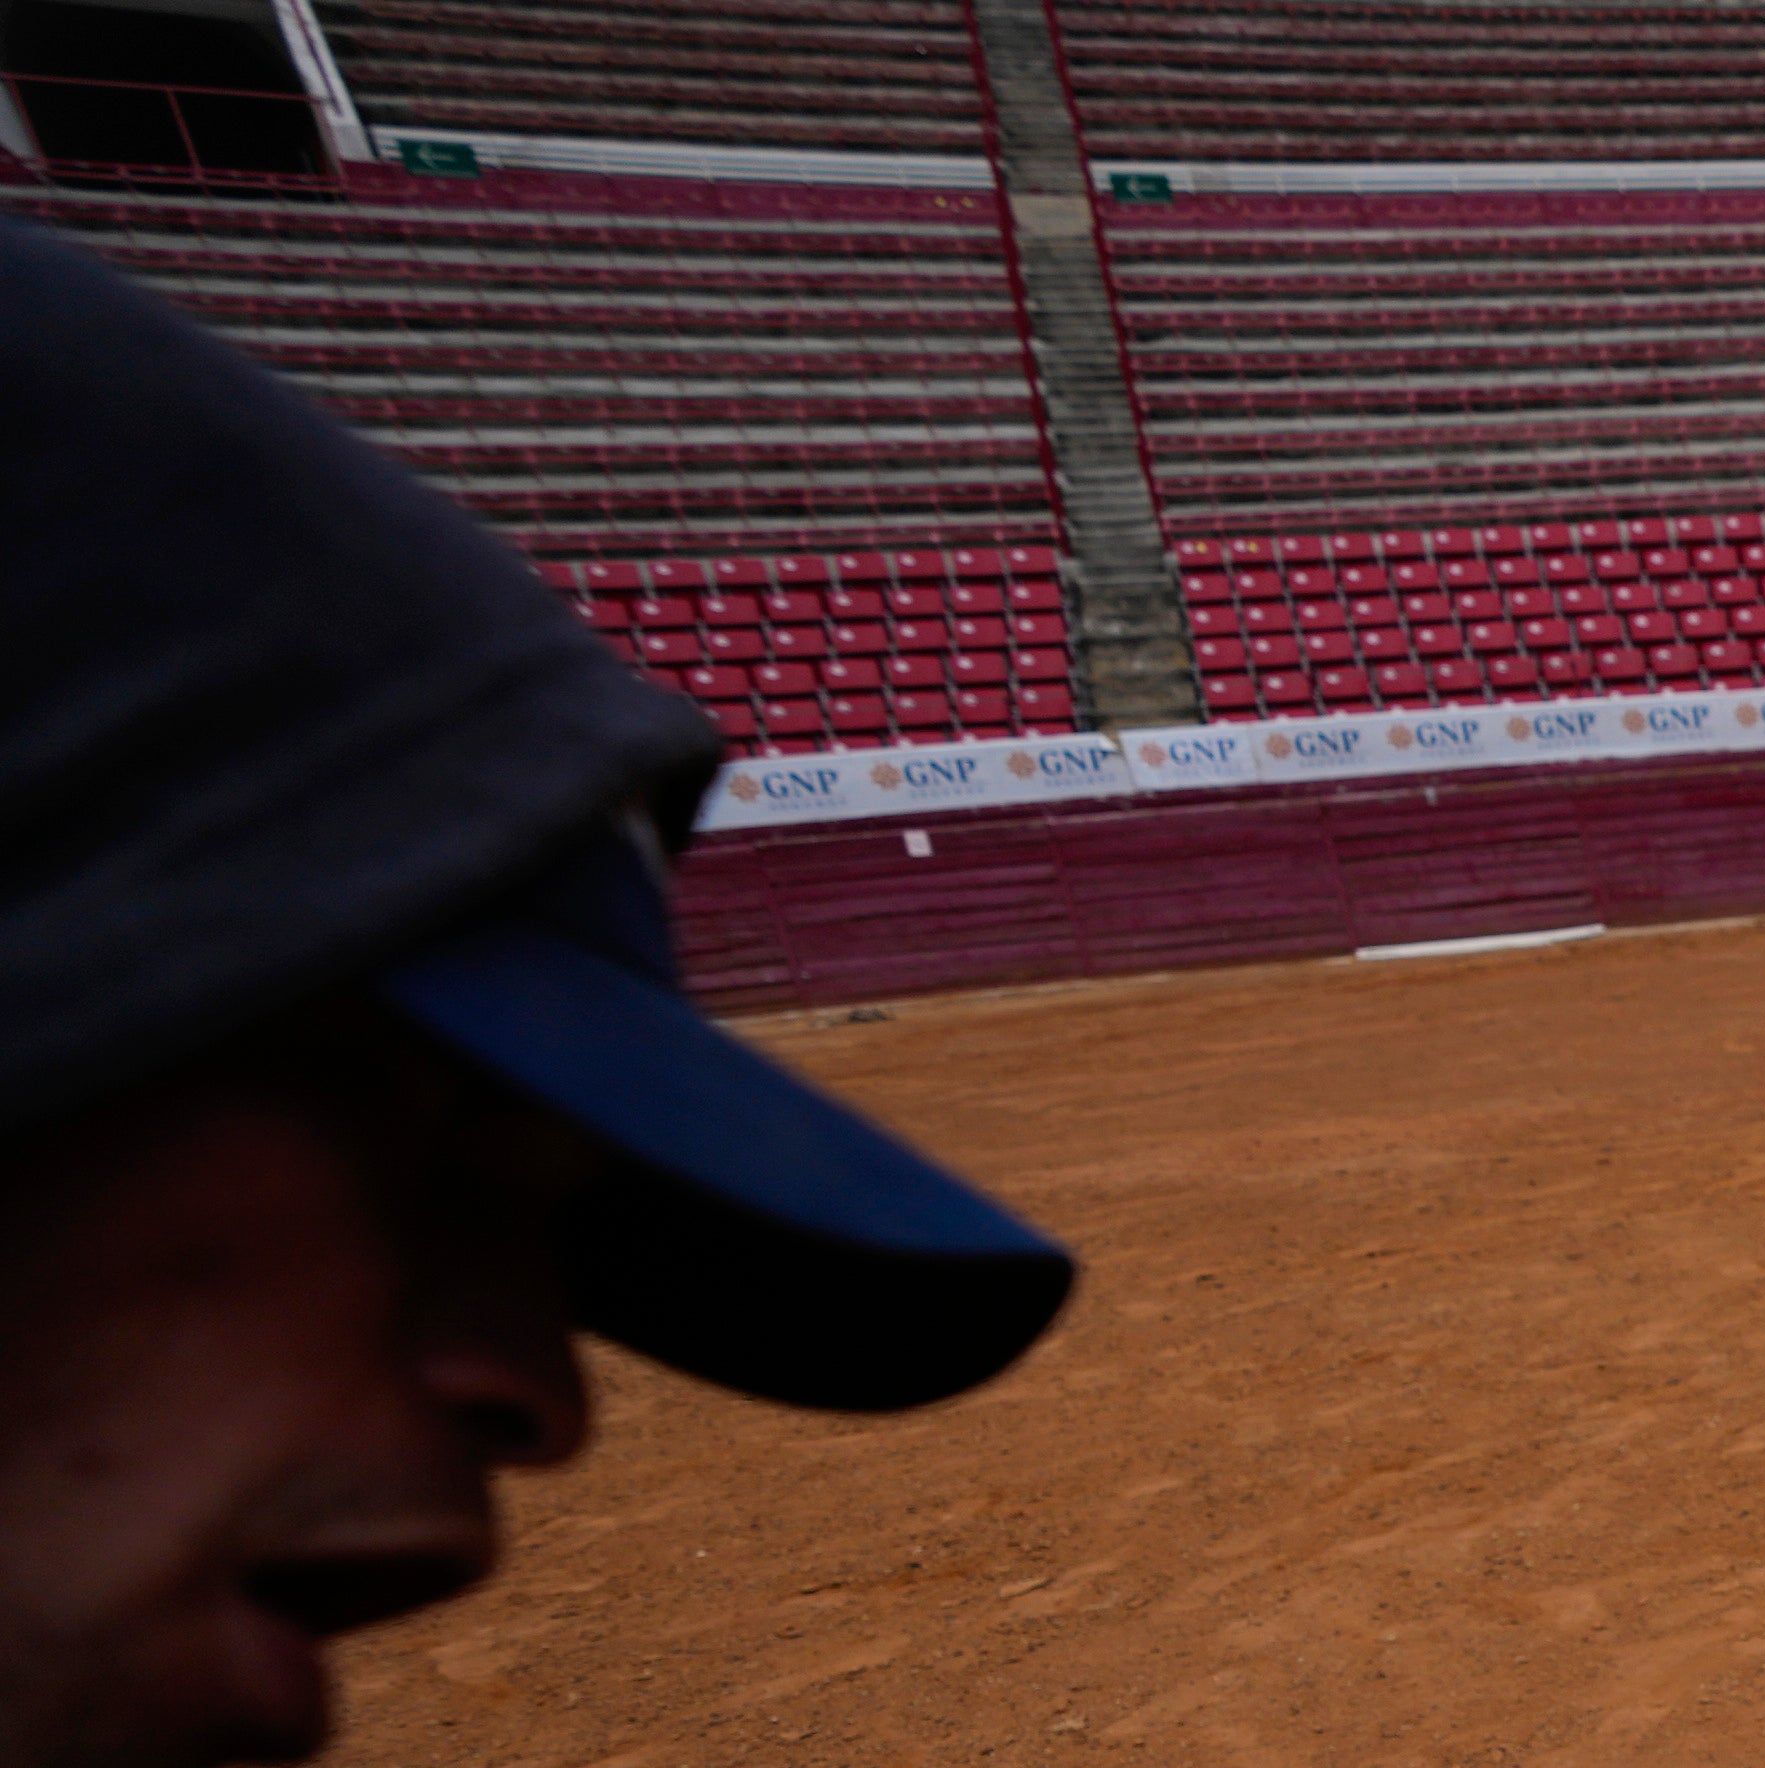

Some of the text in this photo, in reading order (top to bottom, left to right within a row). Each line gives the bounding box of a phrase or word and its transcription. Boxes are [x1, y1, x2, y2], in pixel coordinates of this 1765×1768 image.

[1534, 712, 1595, 738] GNP
[1648, 706, 1709, 732] GNP
[1295, 730, 1359, 756] GNP
[1416, 721, 1478, 747] GNP
[1039, 748, 1111, 775] GNP
[1169, 739, 1235, 765] GNP
[763, 770, 837, 798] GNP
[904, 758, 976, 786] GNP
